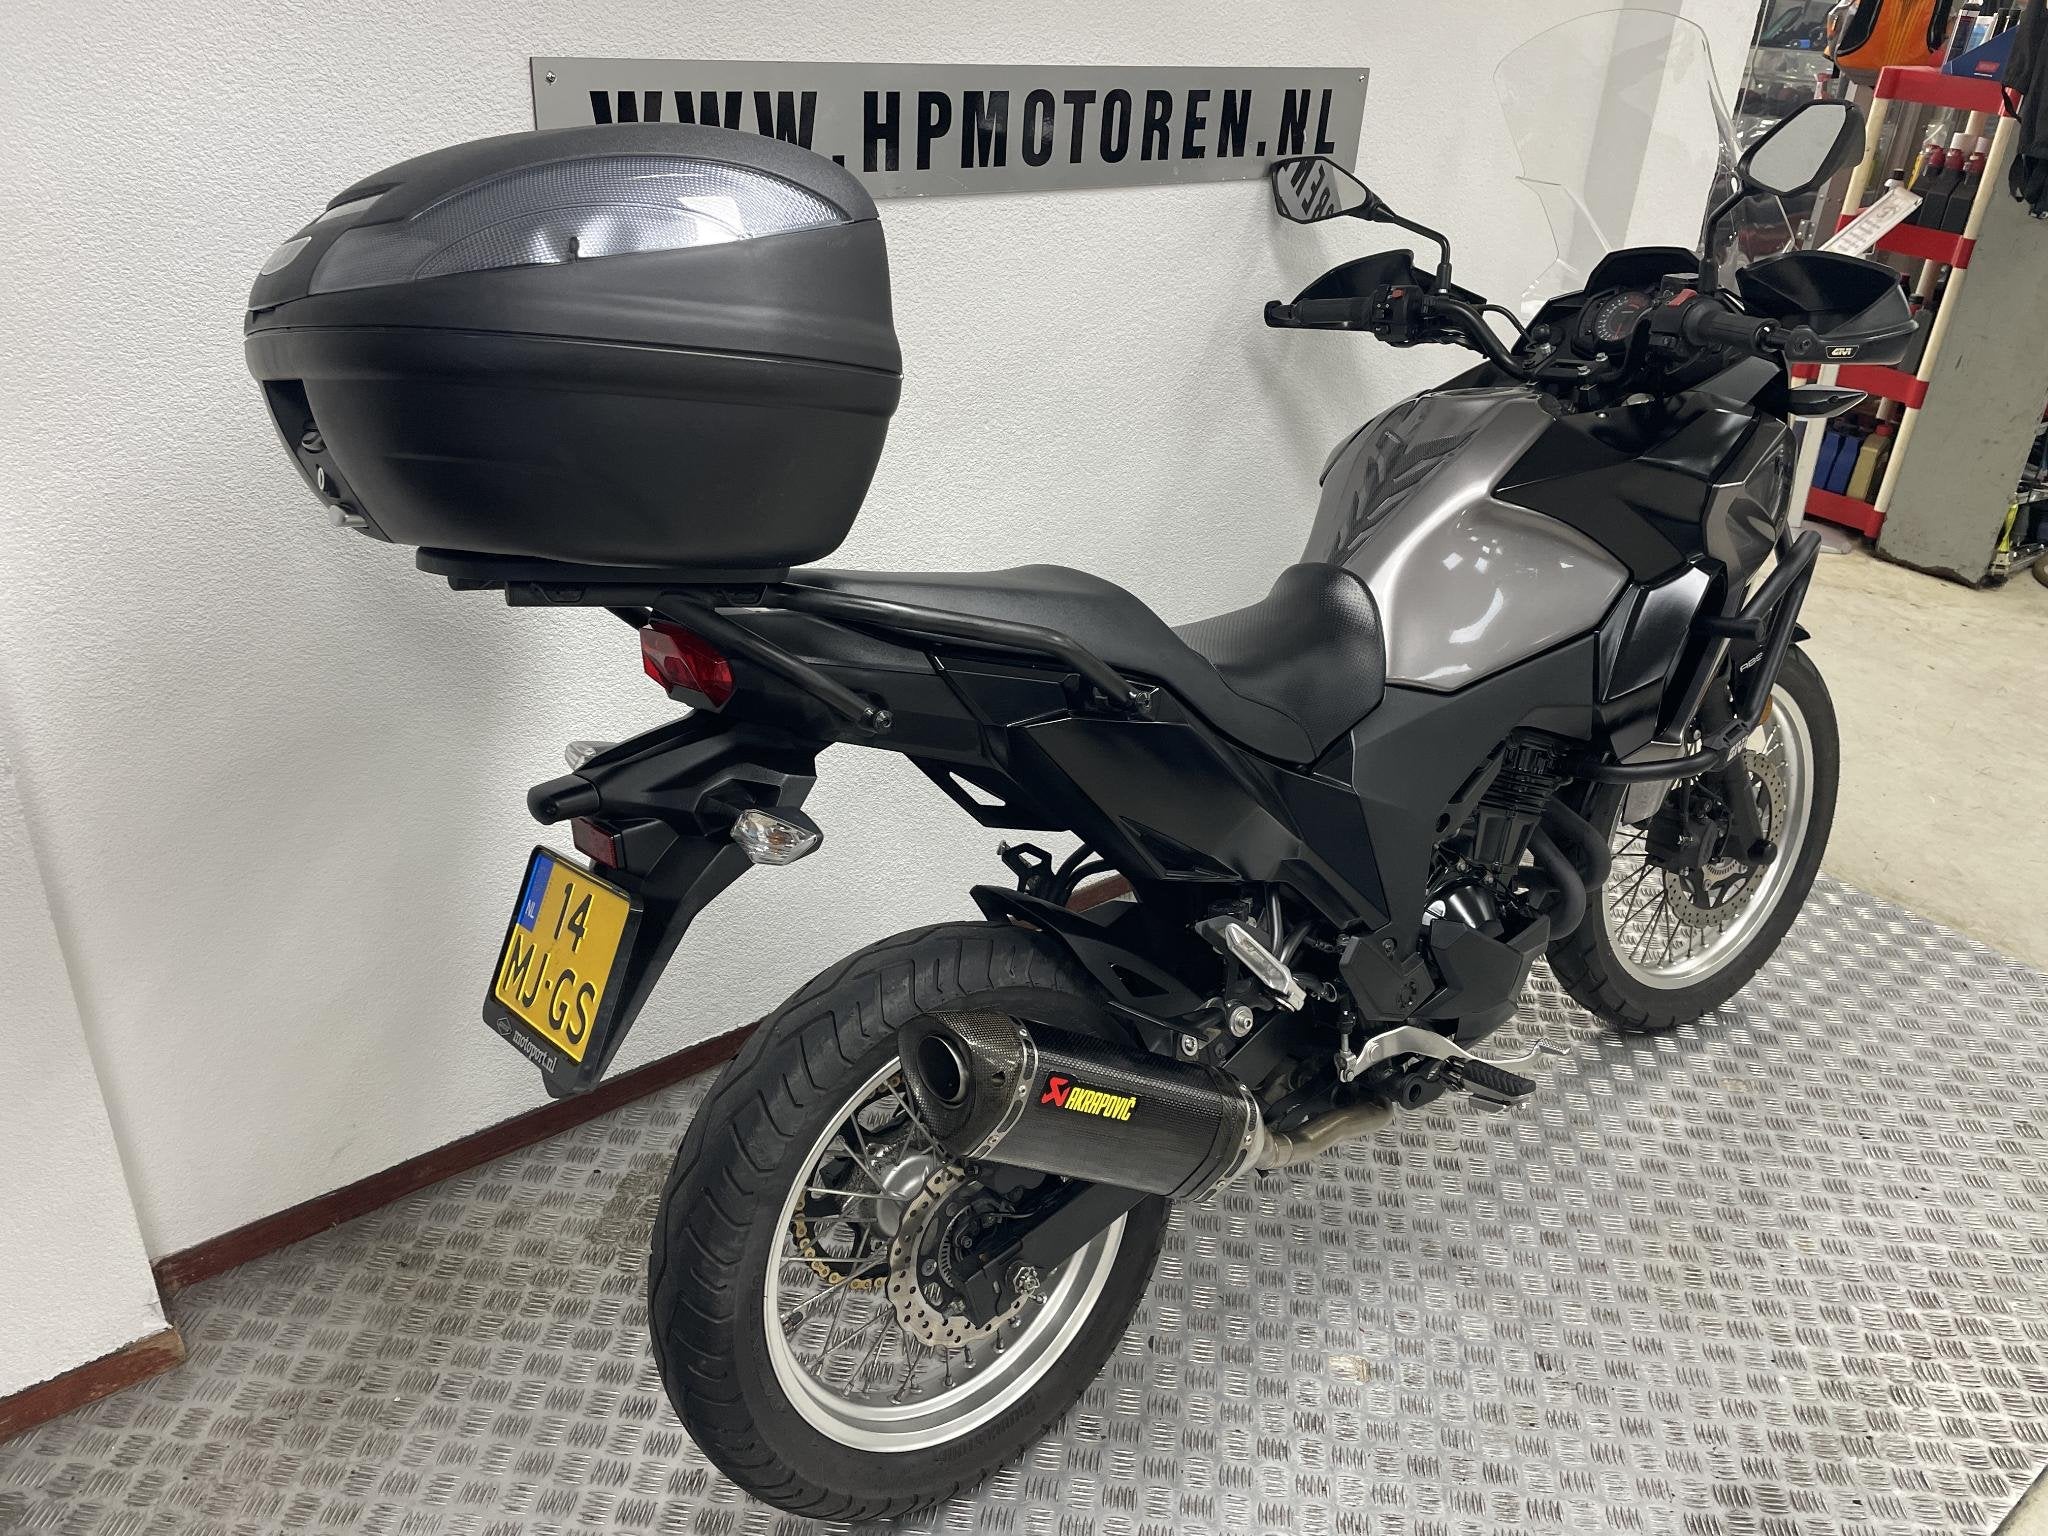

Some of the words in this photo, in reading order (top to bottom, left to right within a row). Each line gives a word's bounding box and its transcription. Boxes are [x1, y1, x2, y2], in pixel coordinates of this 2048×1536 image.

[525, 899, 536, 919] NL
[554, 882, 594, 953] 14
[512, 1030, 558, 1074] motoport.nl
